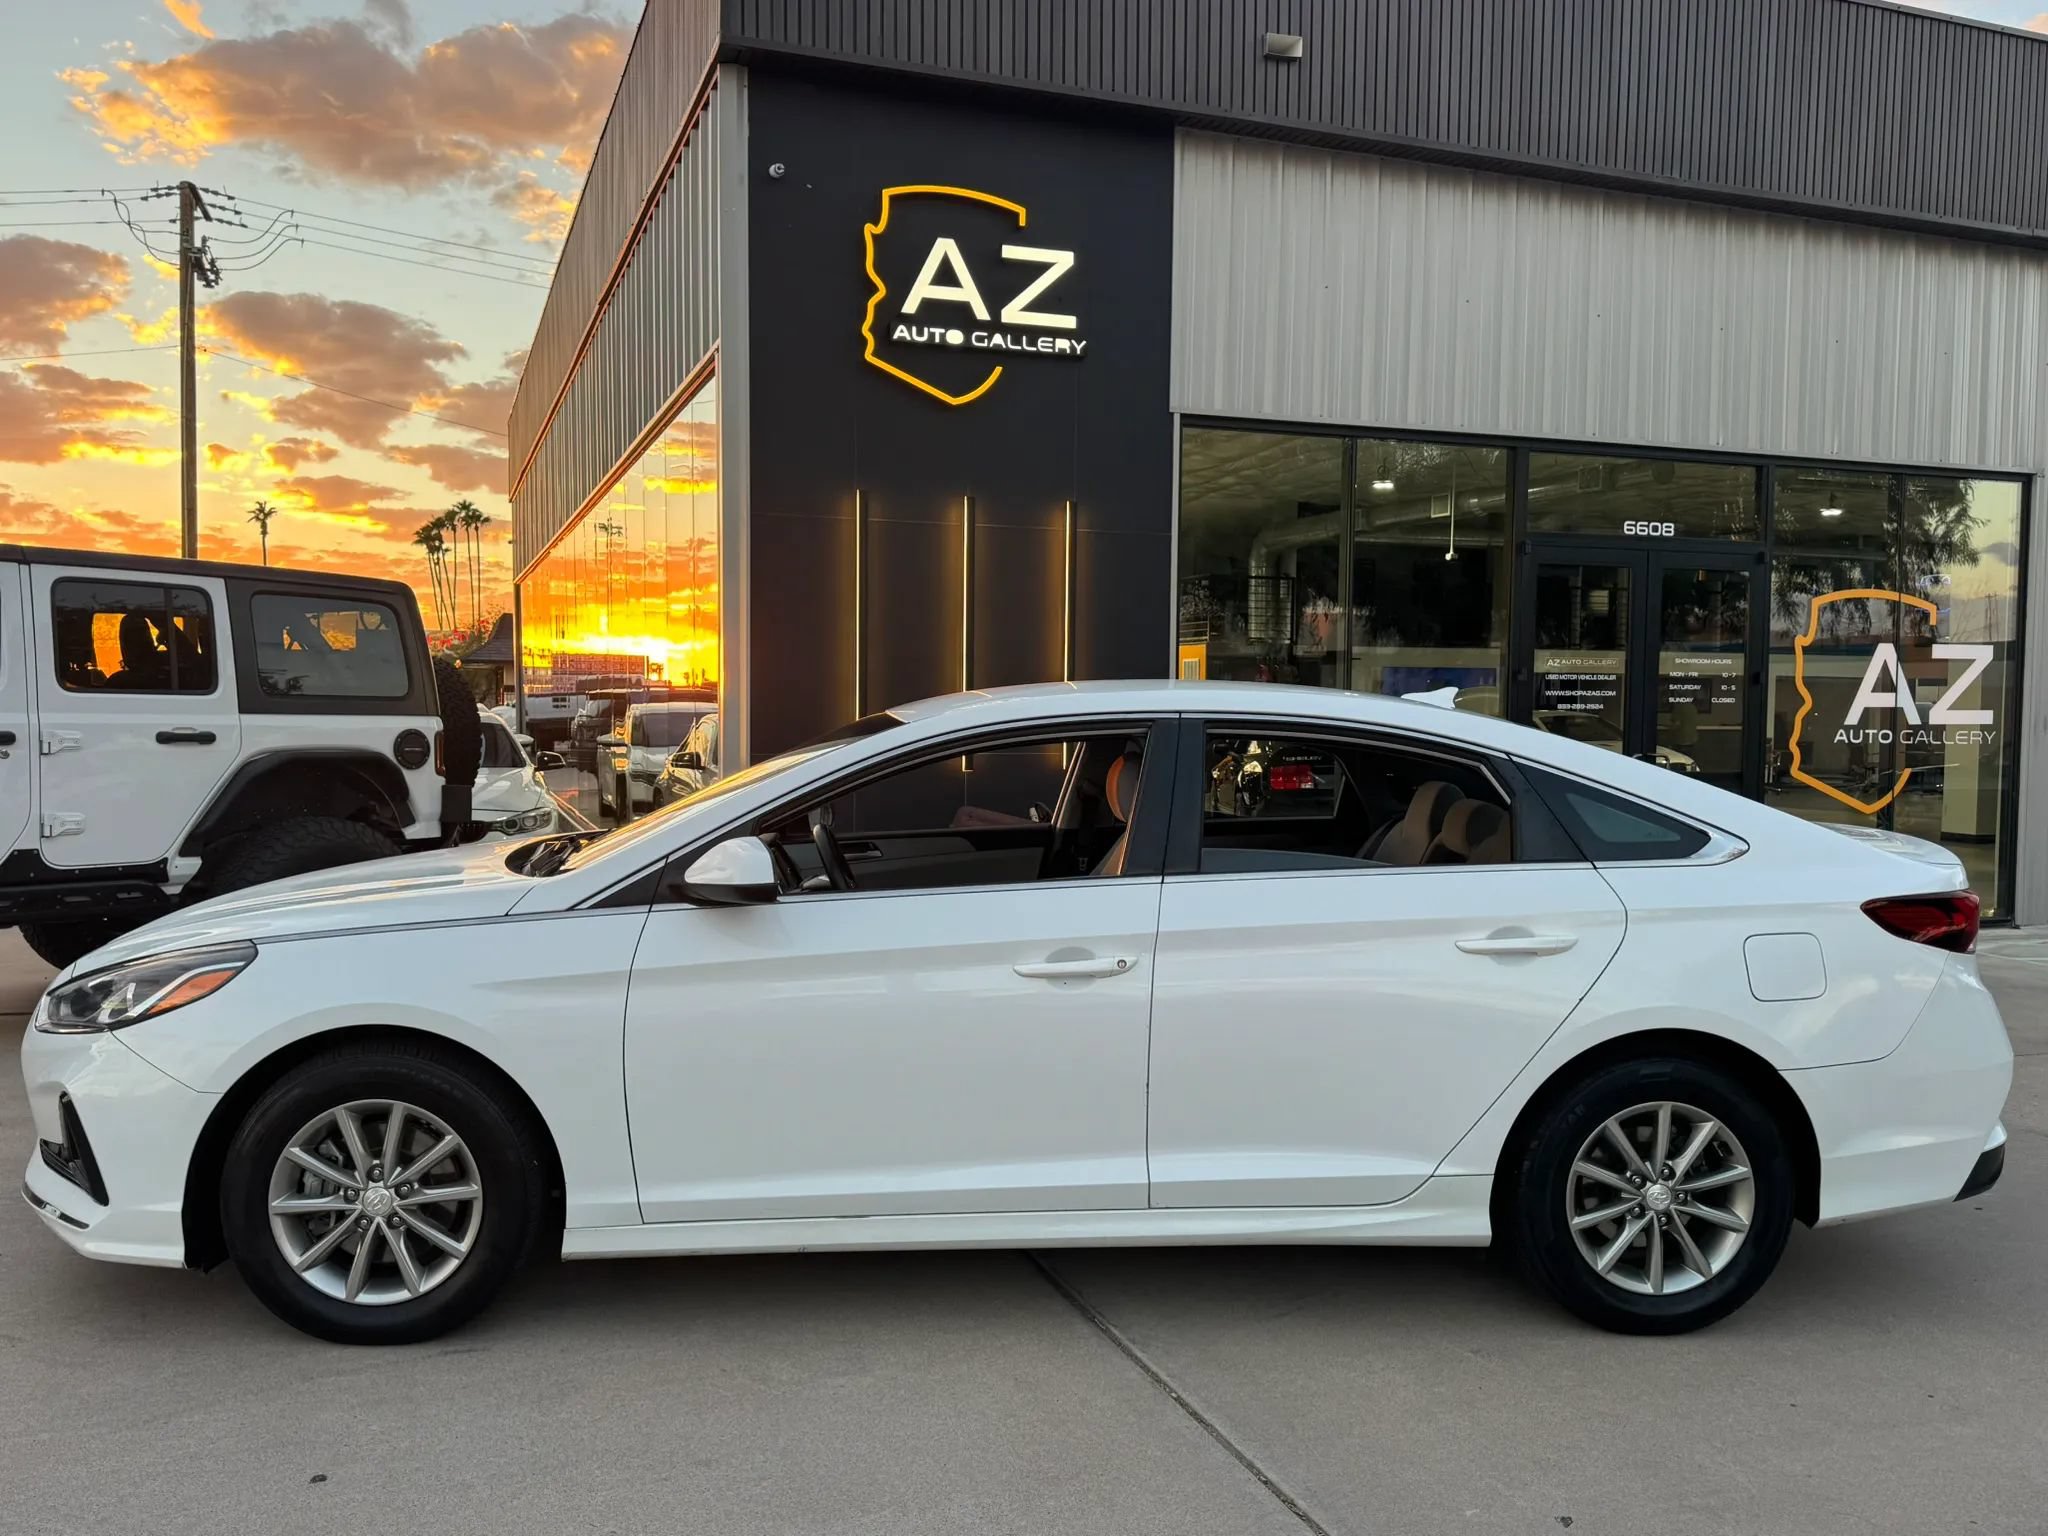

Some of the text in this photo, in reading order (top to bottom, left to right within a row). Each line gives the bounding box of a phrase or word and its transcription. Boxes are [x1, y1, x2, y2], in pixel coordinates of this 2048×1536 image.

[899, 236, 1078, 330] AZ
[892, 324, 1088, 355] AUTO GALLERY
[1623, 520, 1675, 536] 6608
[1843, 642, 1994, 725] AZ
[1833, 729, 1997, 745] AUTO GALLERY
